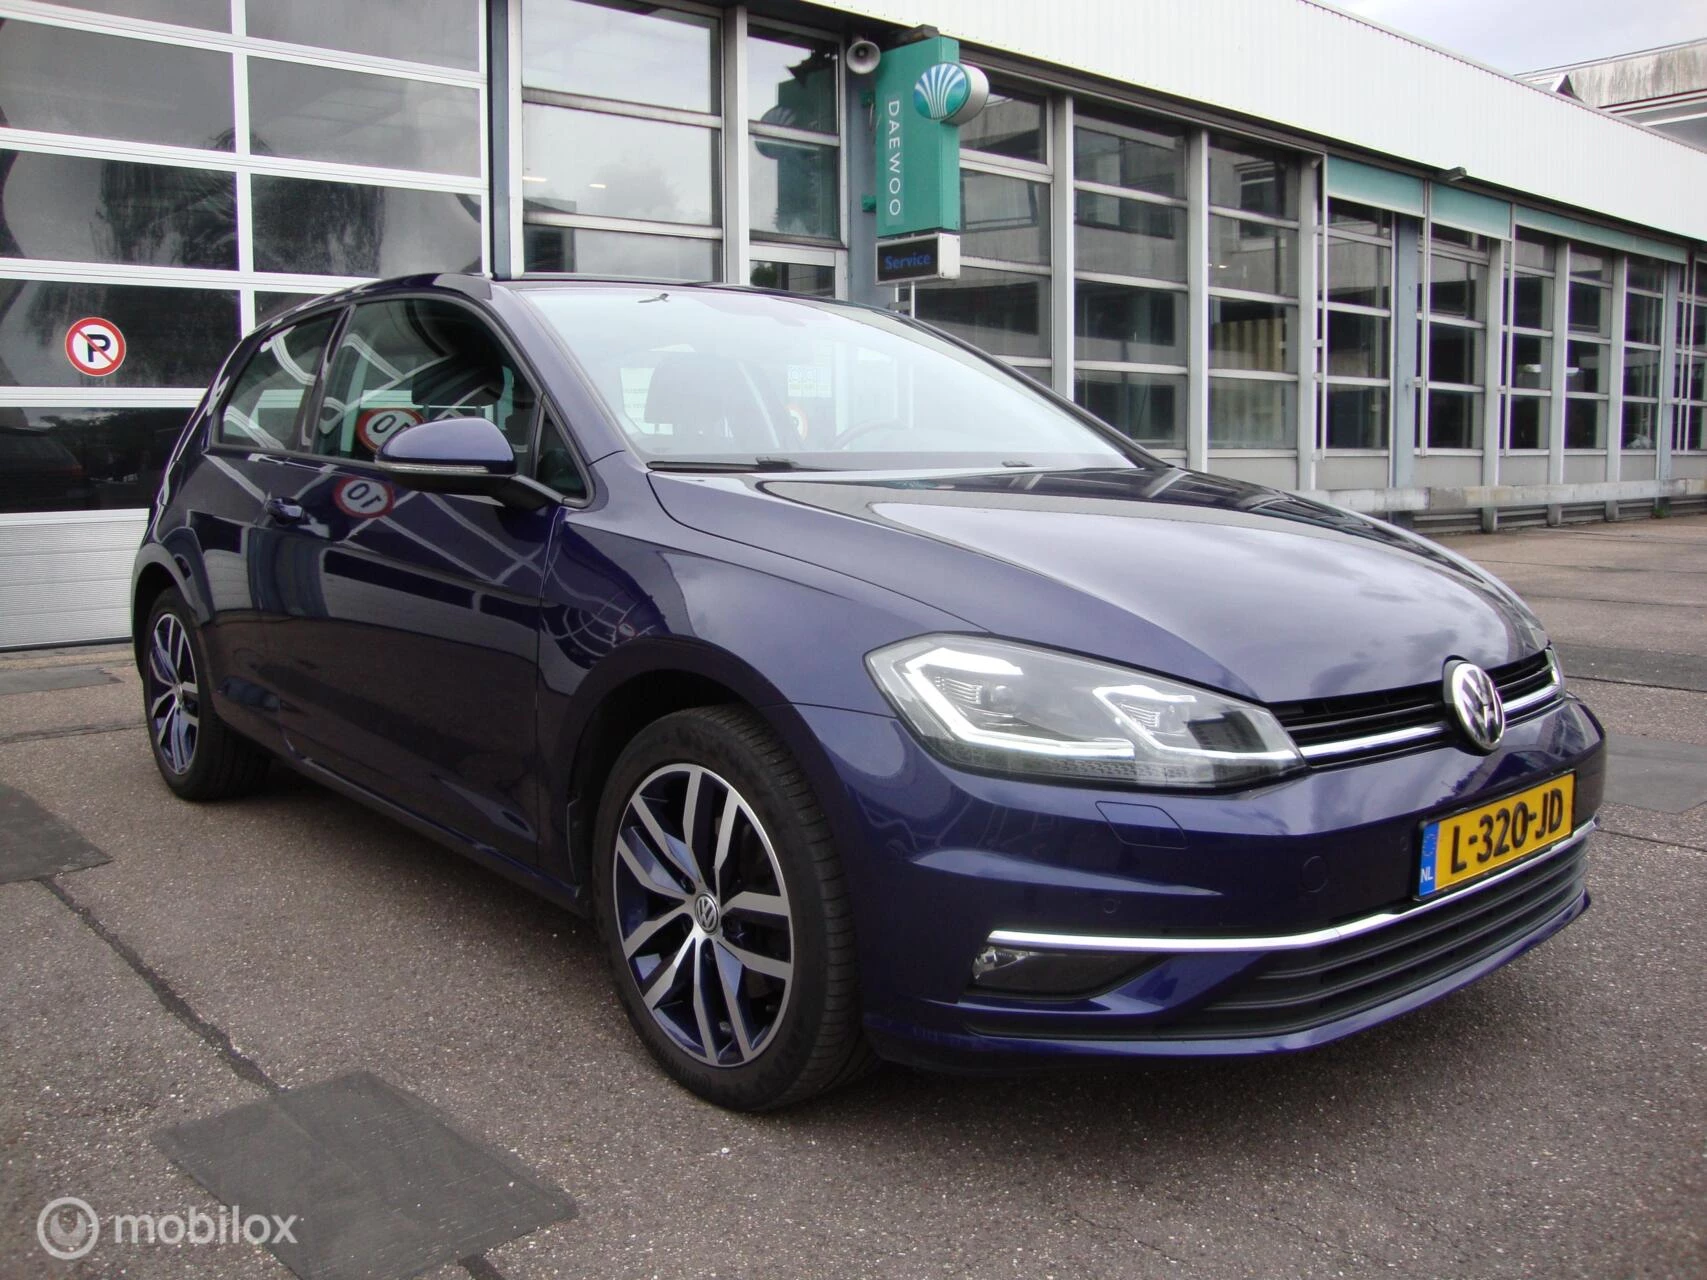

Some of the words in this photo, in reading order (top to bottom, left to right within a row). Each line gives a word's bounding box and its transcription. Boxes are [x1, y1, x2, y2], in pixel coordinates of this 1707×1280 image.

[887, 100, 901, 216] DAEWOO
[884, 251, 932, 271] Service
[87, 333, 111, 363] P
[1450, 787, 1564, 875] L-320-JD
[1420, 867, 1434, 883] NL
